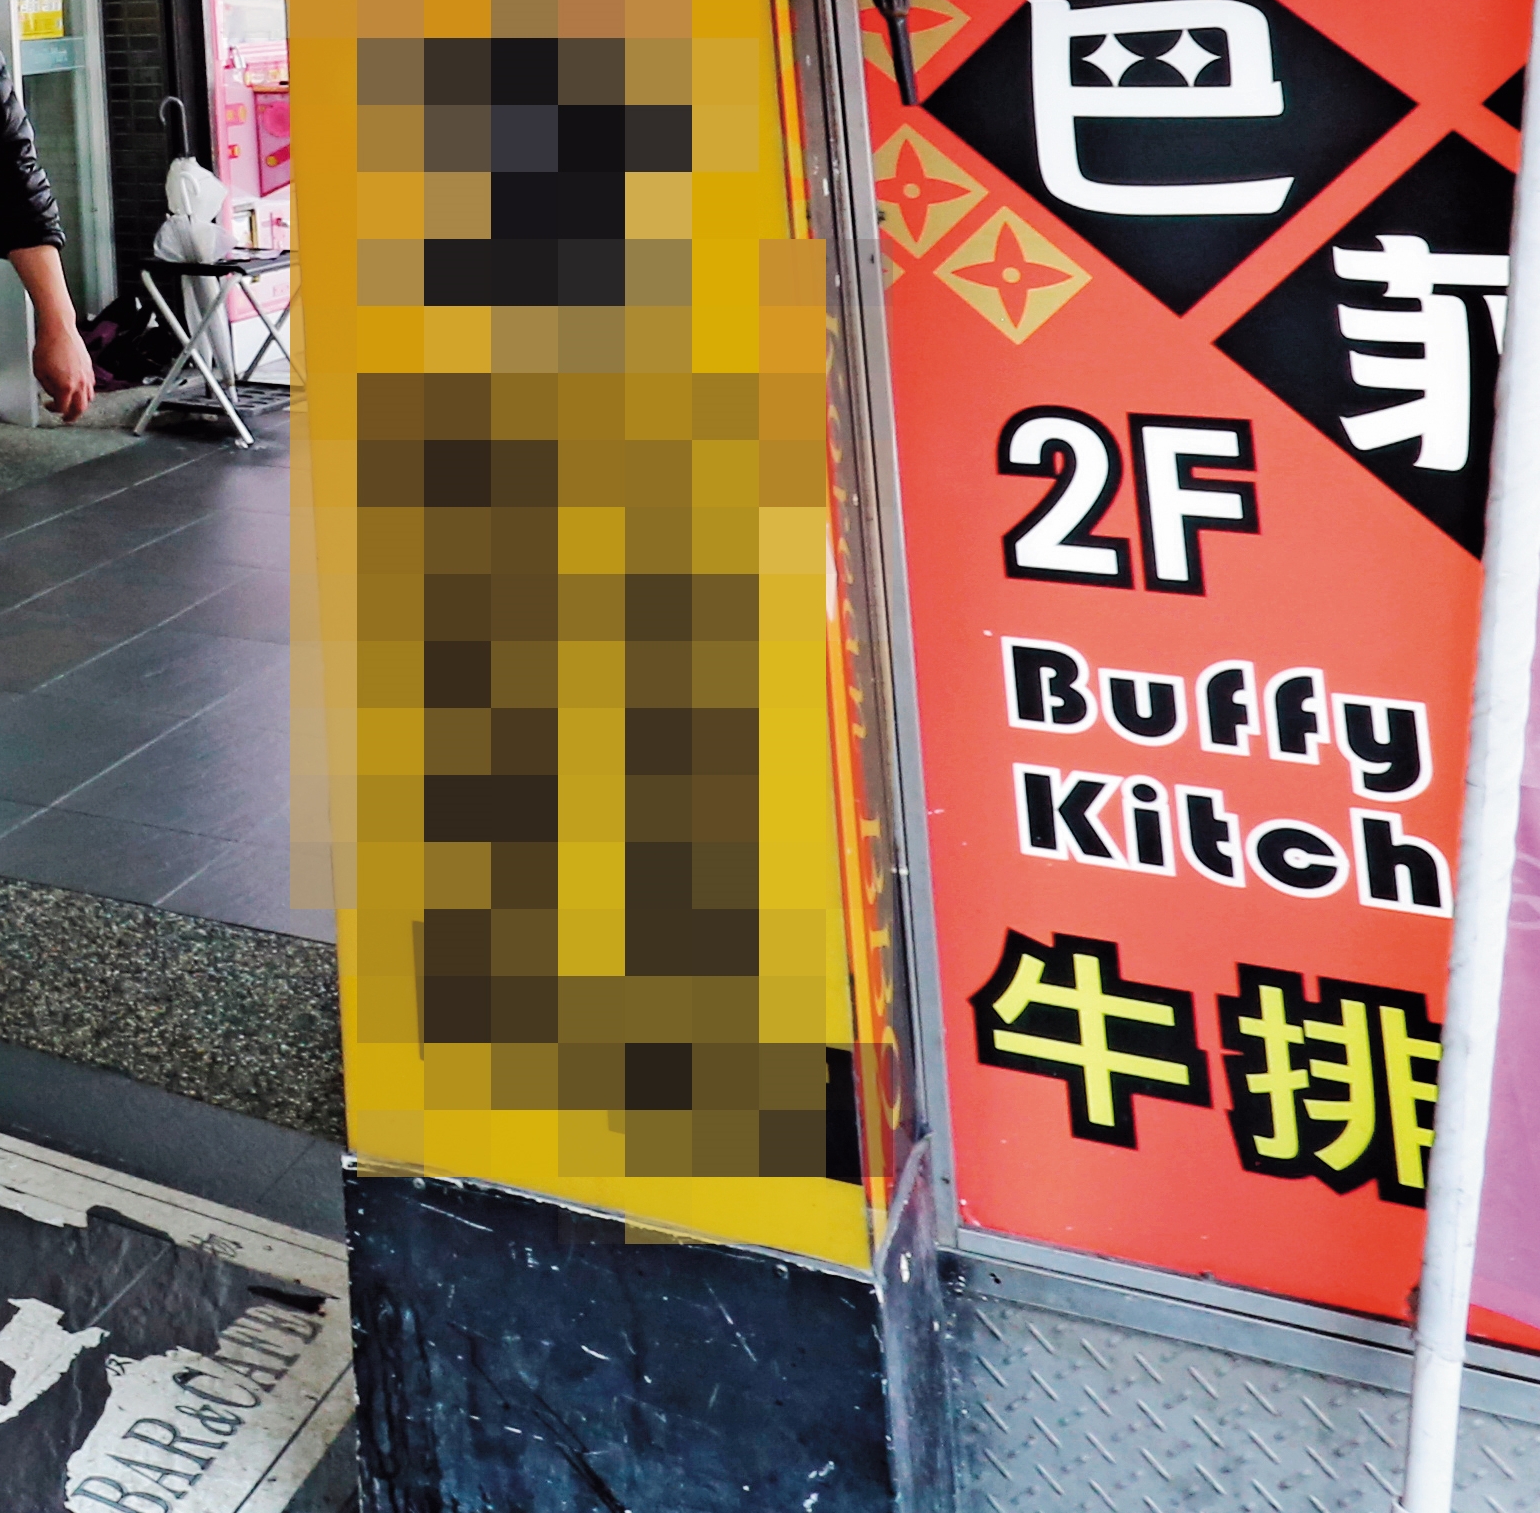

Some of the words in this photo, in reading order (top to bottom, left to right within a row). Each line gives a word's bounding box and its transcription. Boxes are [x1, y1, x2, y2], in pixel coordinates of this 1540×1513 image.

[998, 405, 1262, 597] 2F
[1001, 636, 1436, 804] Buffy
[1012, 763, 1455, 920] Kitch
[990, 951, 1444, 1191] 牛排
